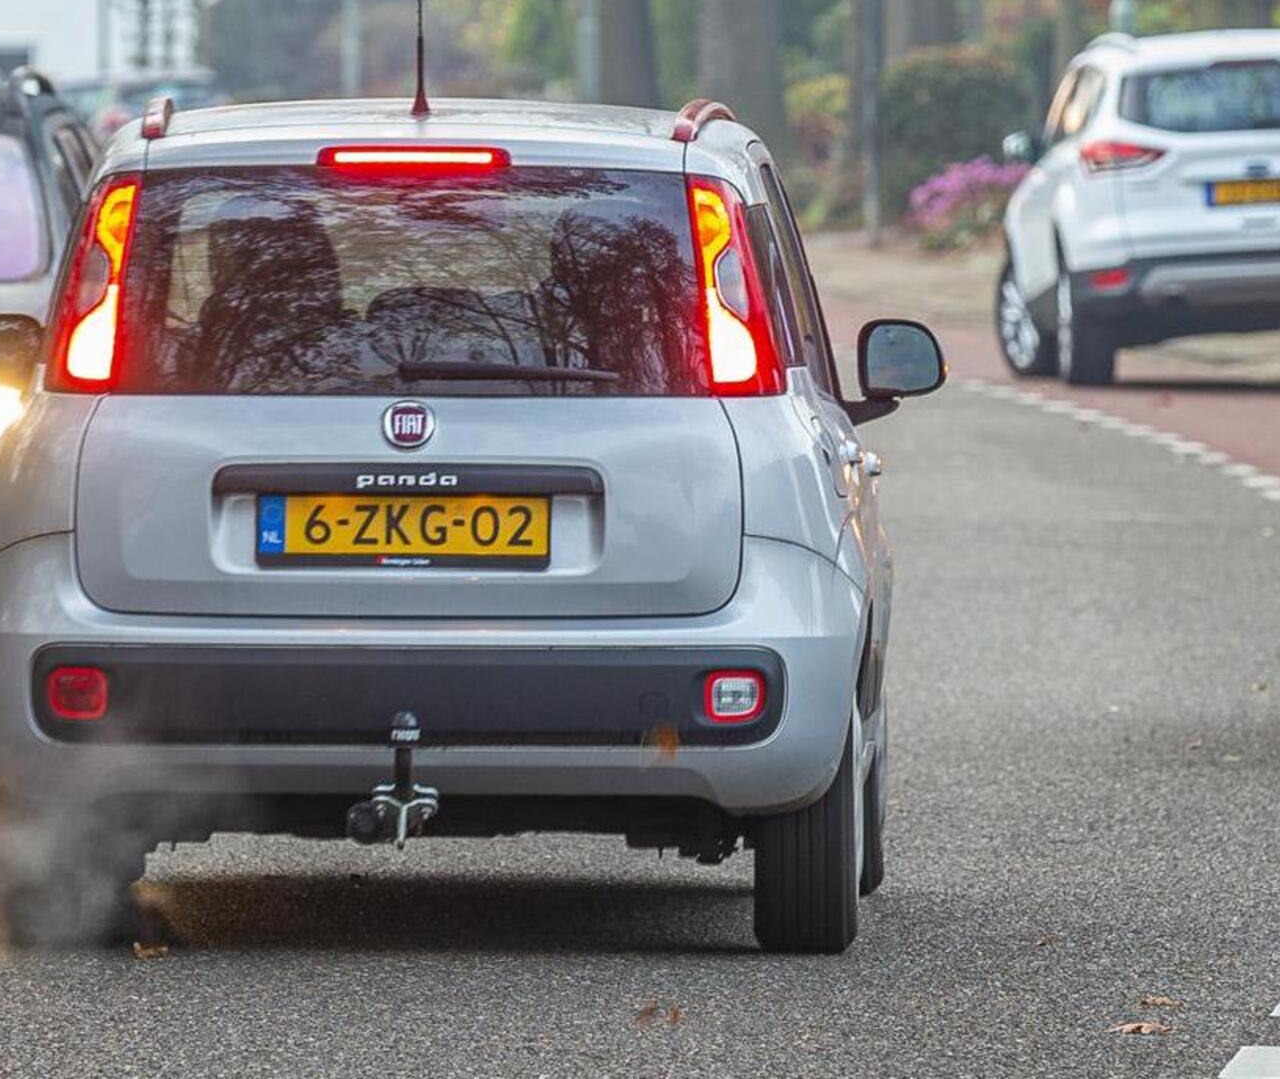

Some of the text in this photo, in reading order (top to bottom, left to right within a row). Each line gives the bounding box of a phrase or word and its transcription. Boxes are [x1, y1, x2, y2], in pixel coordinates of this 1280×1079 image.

[393, 413, 425, 435] FIAT
[356, 472, 459, 488] panda
[304, 504, 534, 547] 6-ZKG-02
[261, 530, 282, 544] NL
